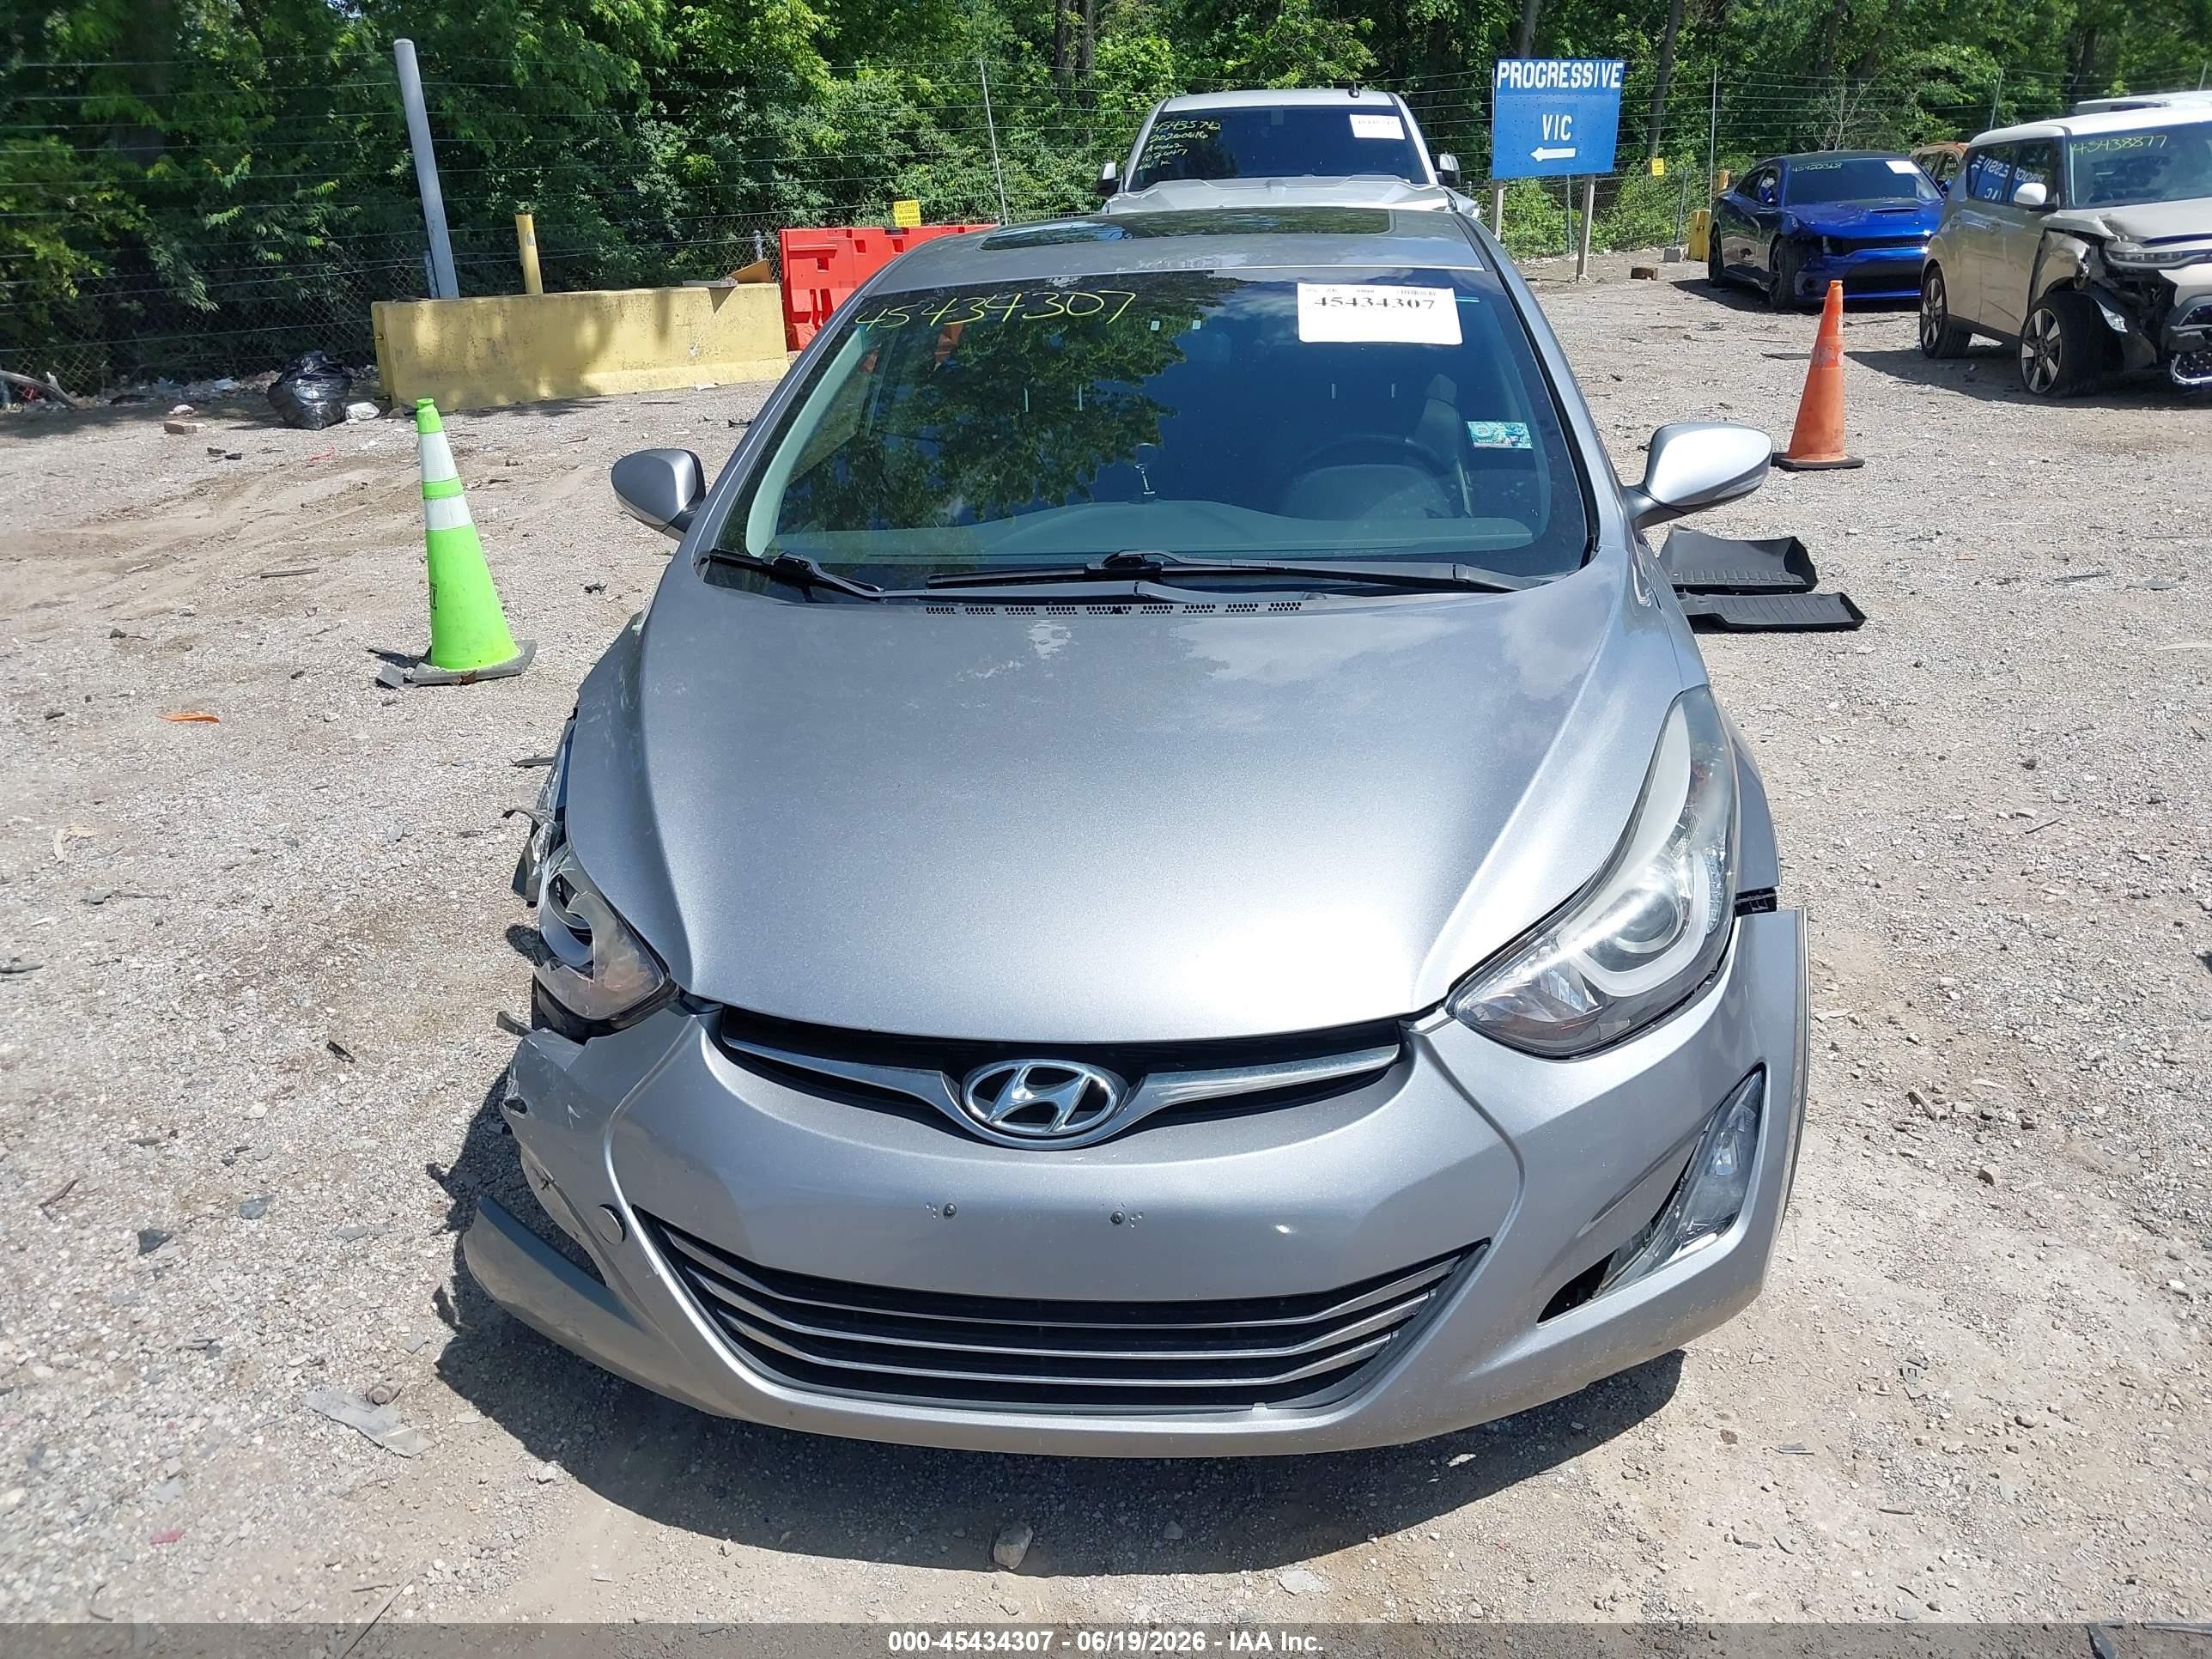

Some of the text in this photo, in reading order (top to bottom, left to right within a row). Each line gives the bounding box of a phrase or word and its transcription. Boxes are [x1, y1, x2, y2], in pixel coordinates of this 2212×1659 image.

[1497, 61, 1623, 88] PROGRESSIVE
[1542, 114, 1572, 141] VIC
[1314, 296, 1436, 310] 45434307
